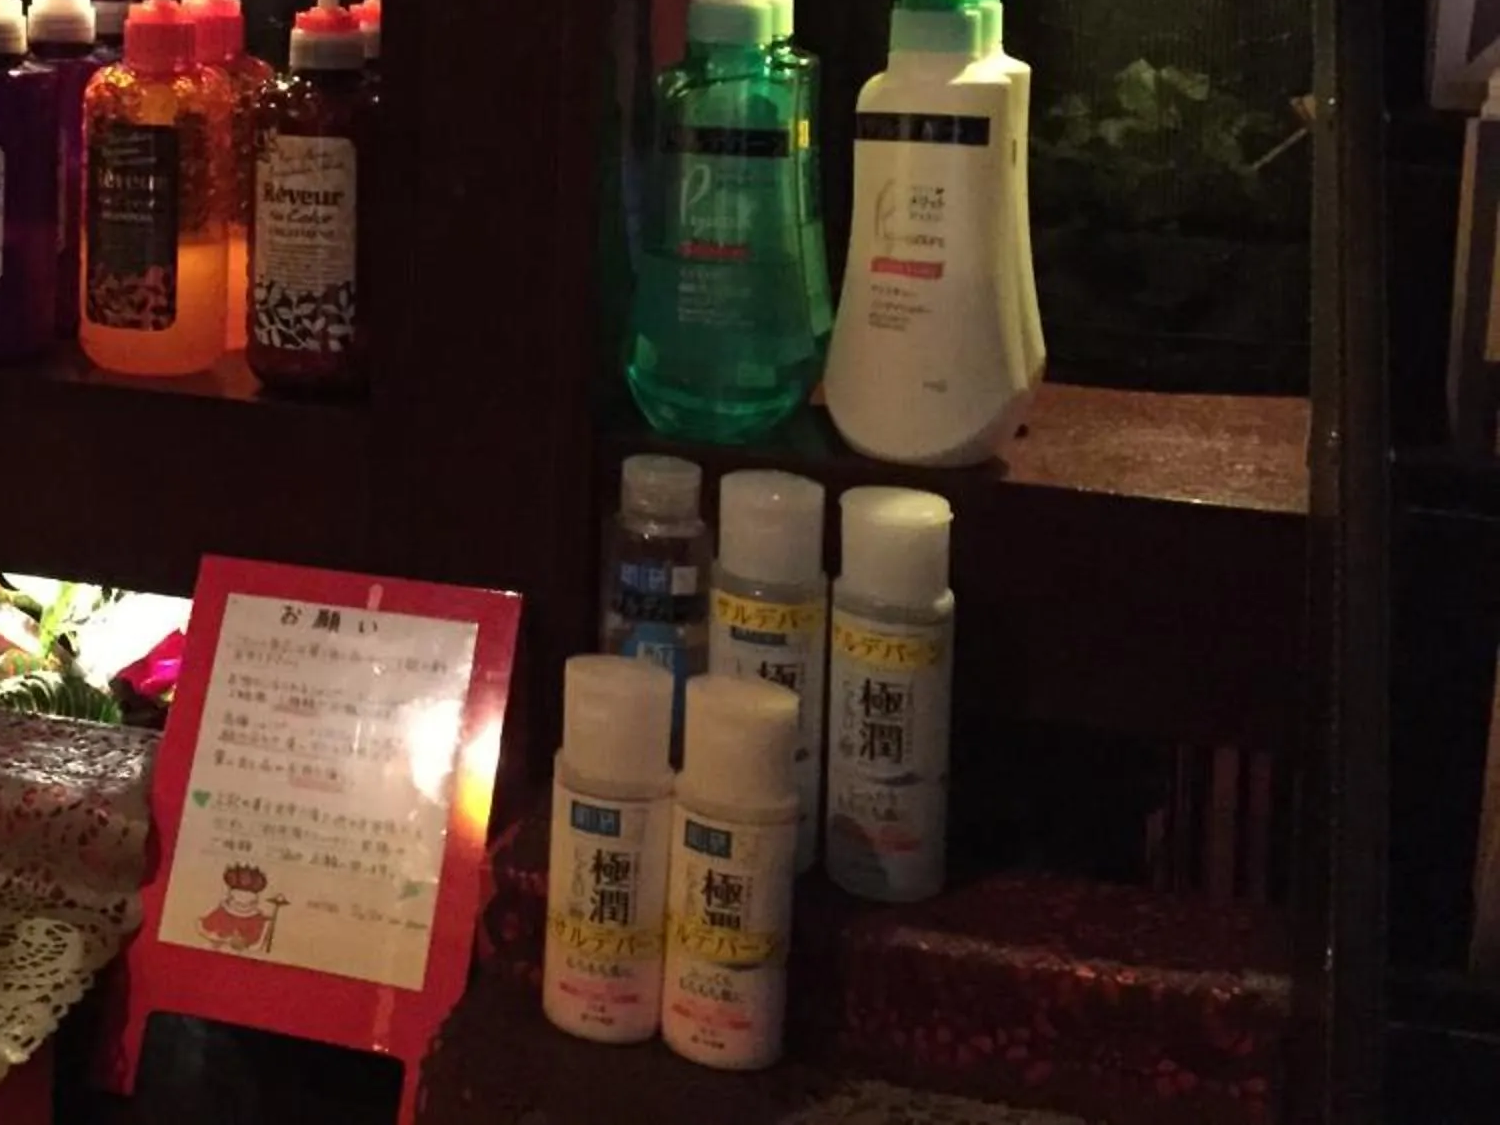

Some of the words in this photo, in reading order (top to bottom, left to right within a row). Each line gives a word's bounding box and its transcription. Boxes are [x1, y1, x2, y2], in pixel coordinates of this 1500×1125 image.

[280, 604, 379, 634] お願い
[857, 677, 903, 764] 極潤
[588, 848, 632, 925] 極潤
